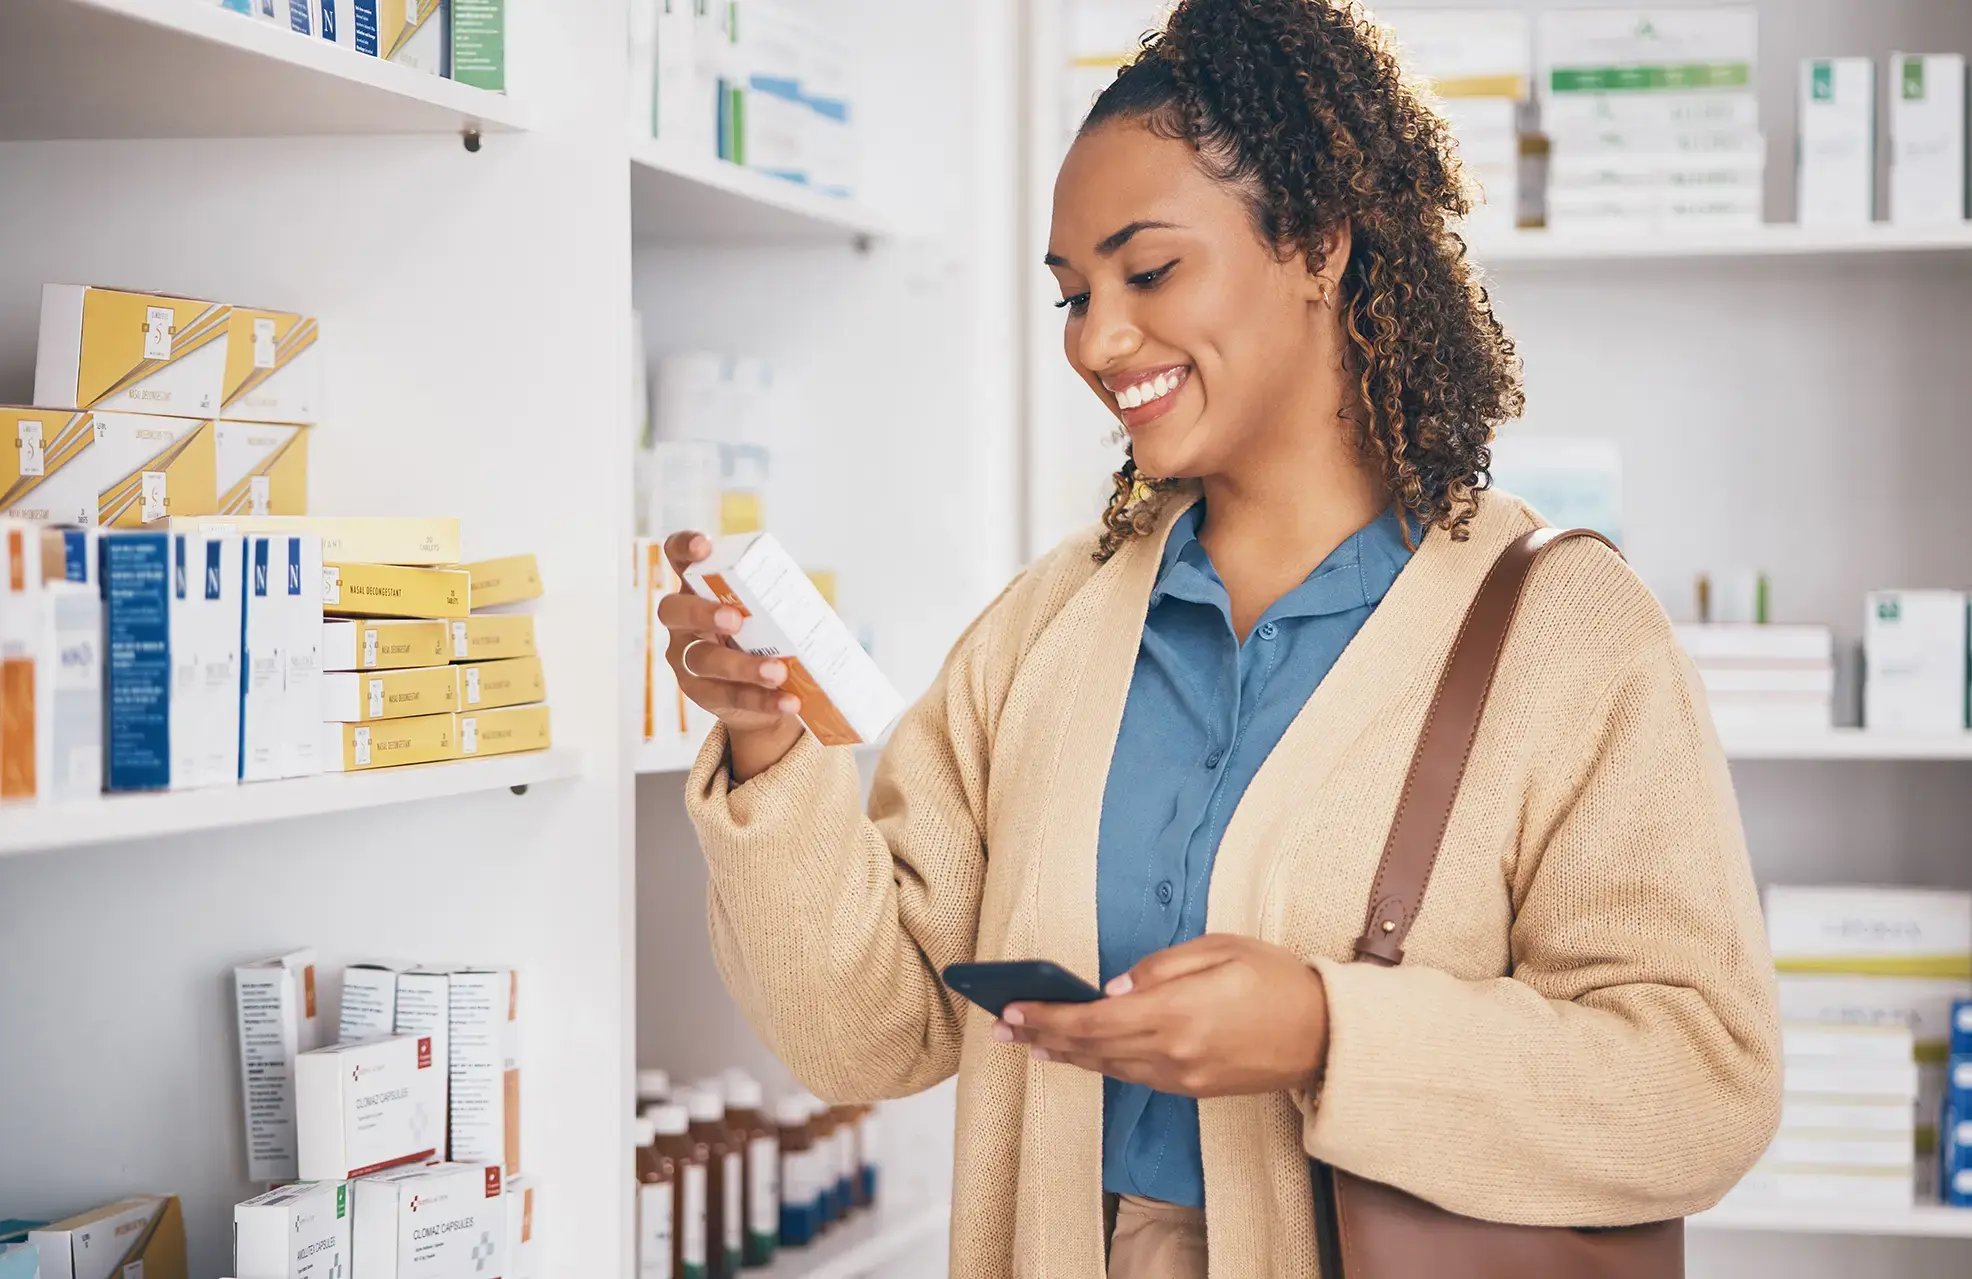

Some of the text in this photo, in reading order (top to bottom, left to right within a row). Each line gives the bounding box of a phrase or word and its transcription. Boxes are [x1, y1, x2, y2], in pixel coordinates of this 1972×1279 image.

[322, 8, 334, 34] N
[207, 566, 219, 594] N
[256, 564, 267, 590] N
[288, 563, 299, 588] N
[349, 585, 402, 598] NASAL DECONGESTANT
[413, 1216, 475, 1241] CLOMAZ CAPSULES
